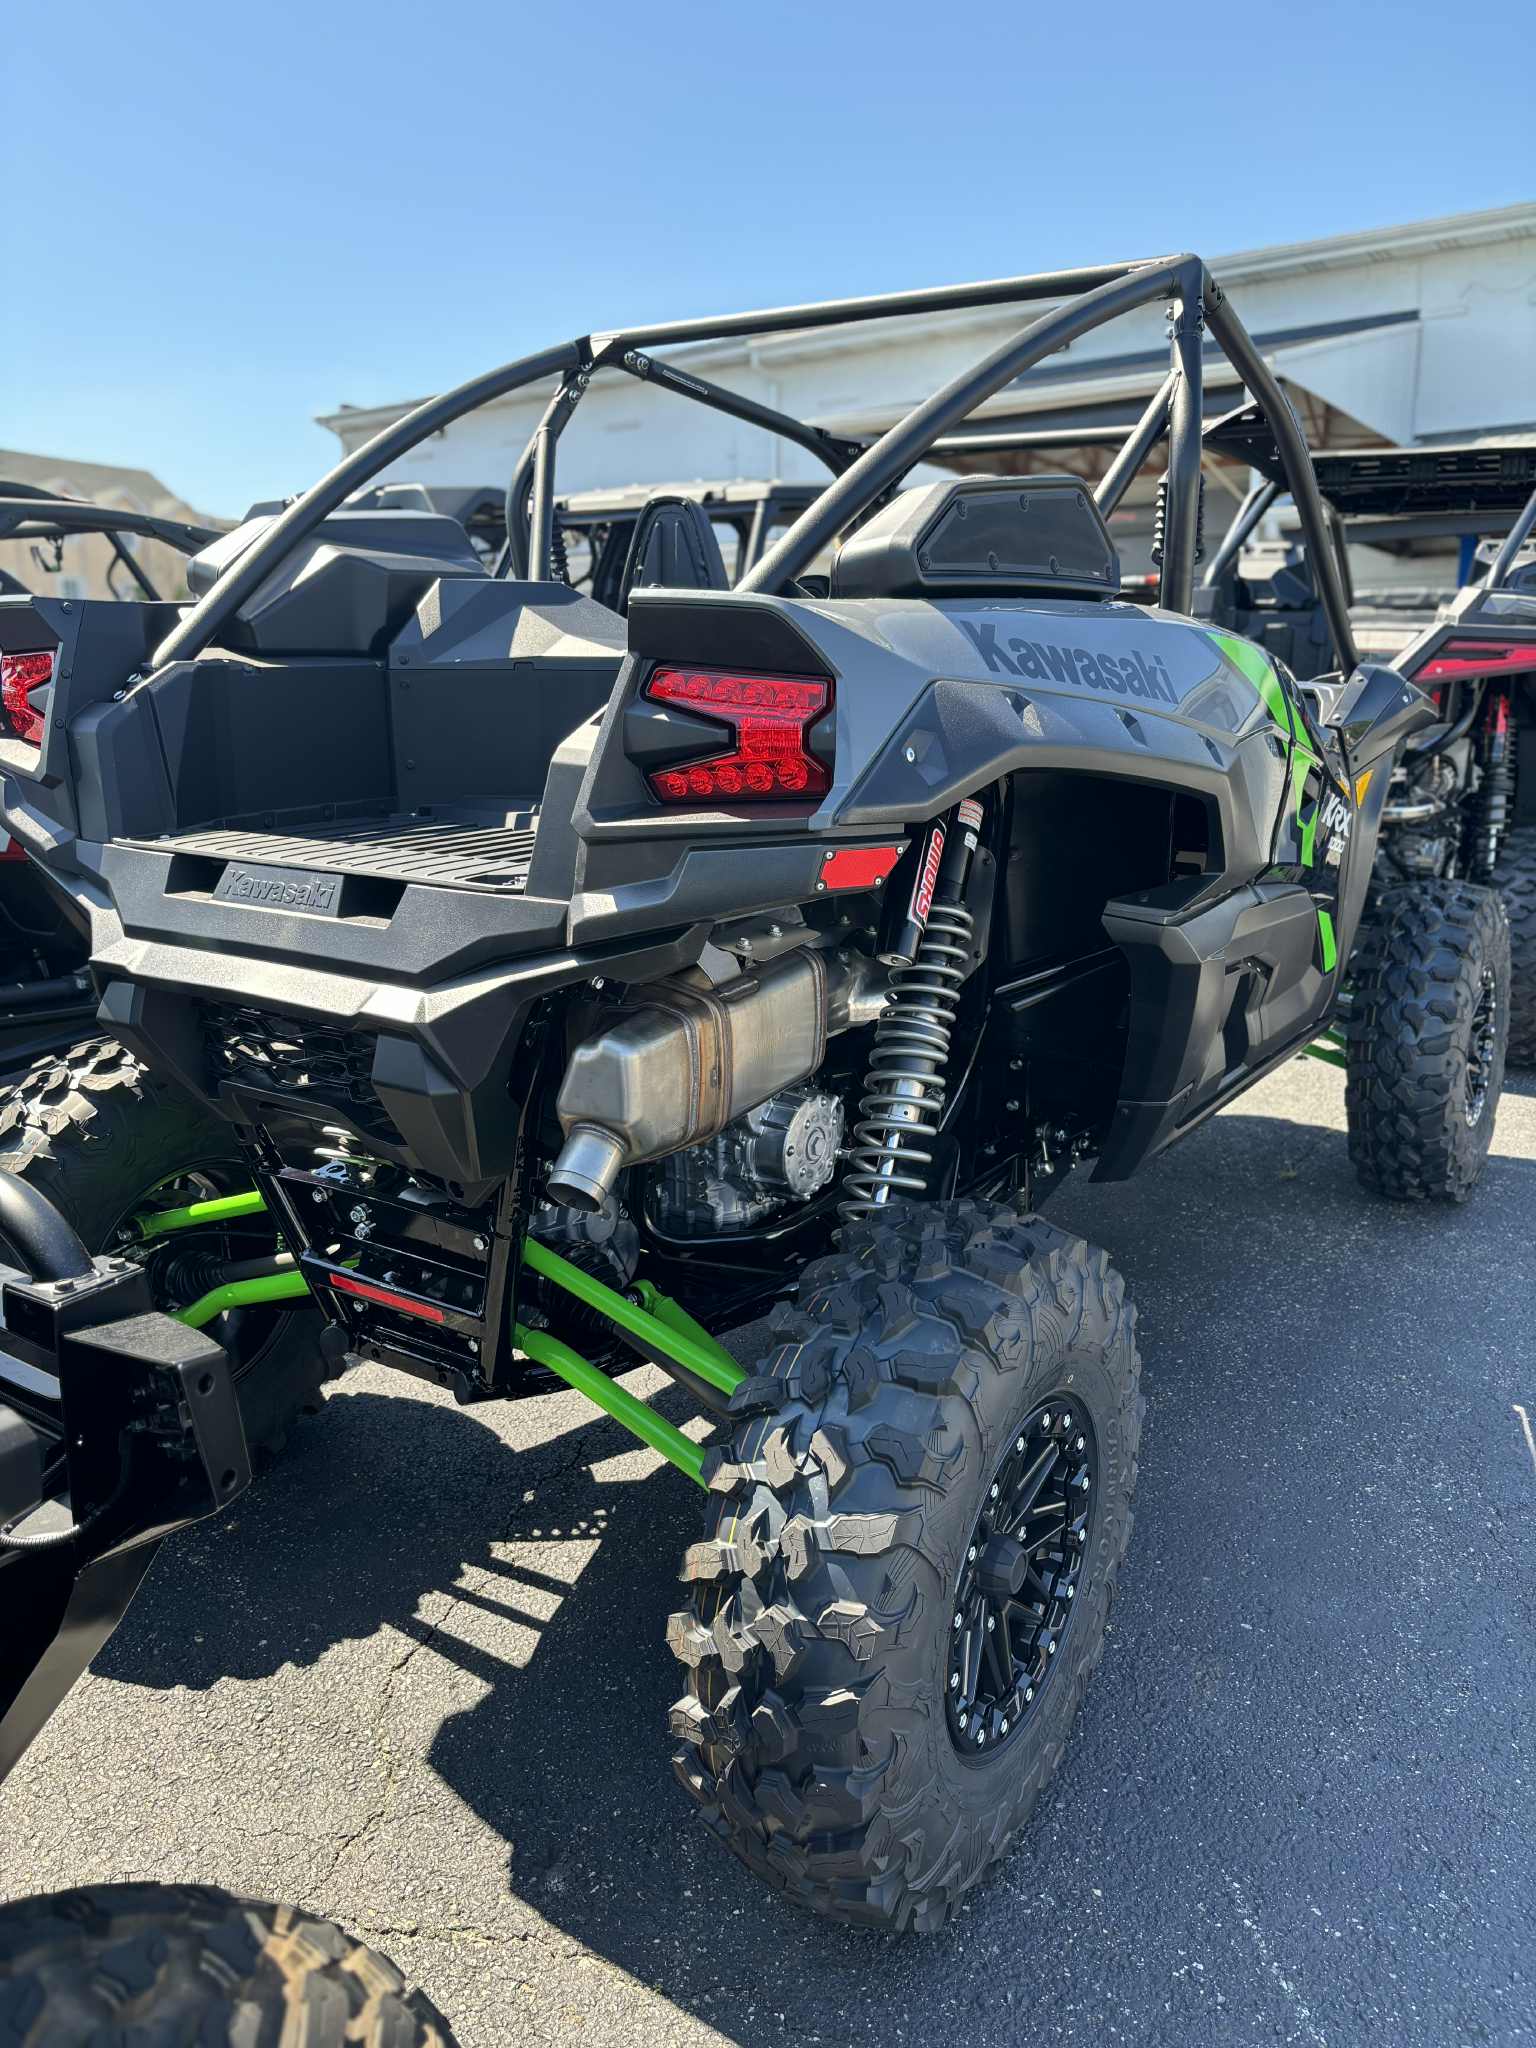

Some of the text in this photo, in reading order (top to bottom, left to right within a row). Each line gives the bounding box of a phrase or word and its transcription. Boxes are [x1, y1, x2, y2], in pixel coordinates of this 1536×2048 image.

[960, 619, 1179, 704] Kawasaki
[1322, 794, 1352, 837] KRX
[222, 868, 336, 909] Kawasaki
[916, 828, 945, 921] SHOWA
